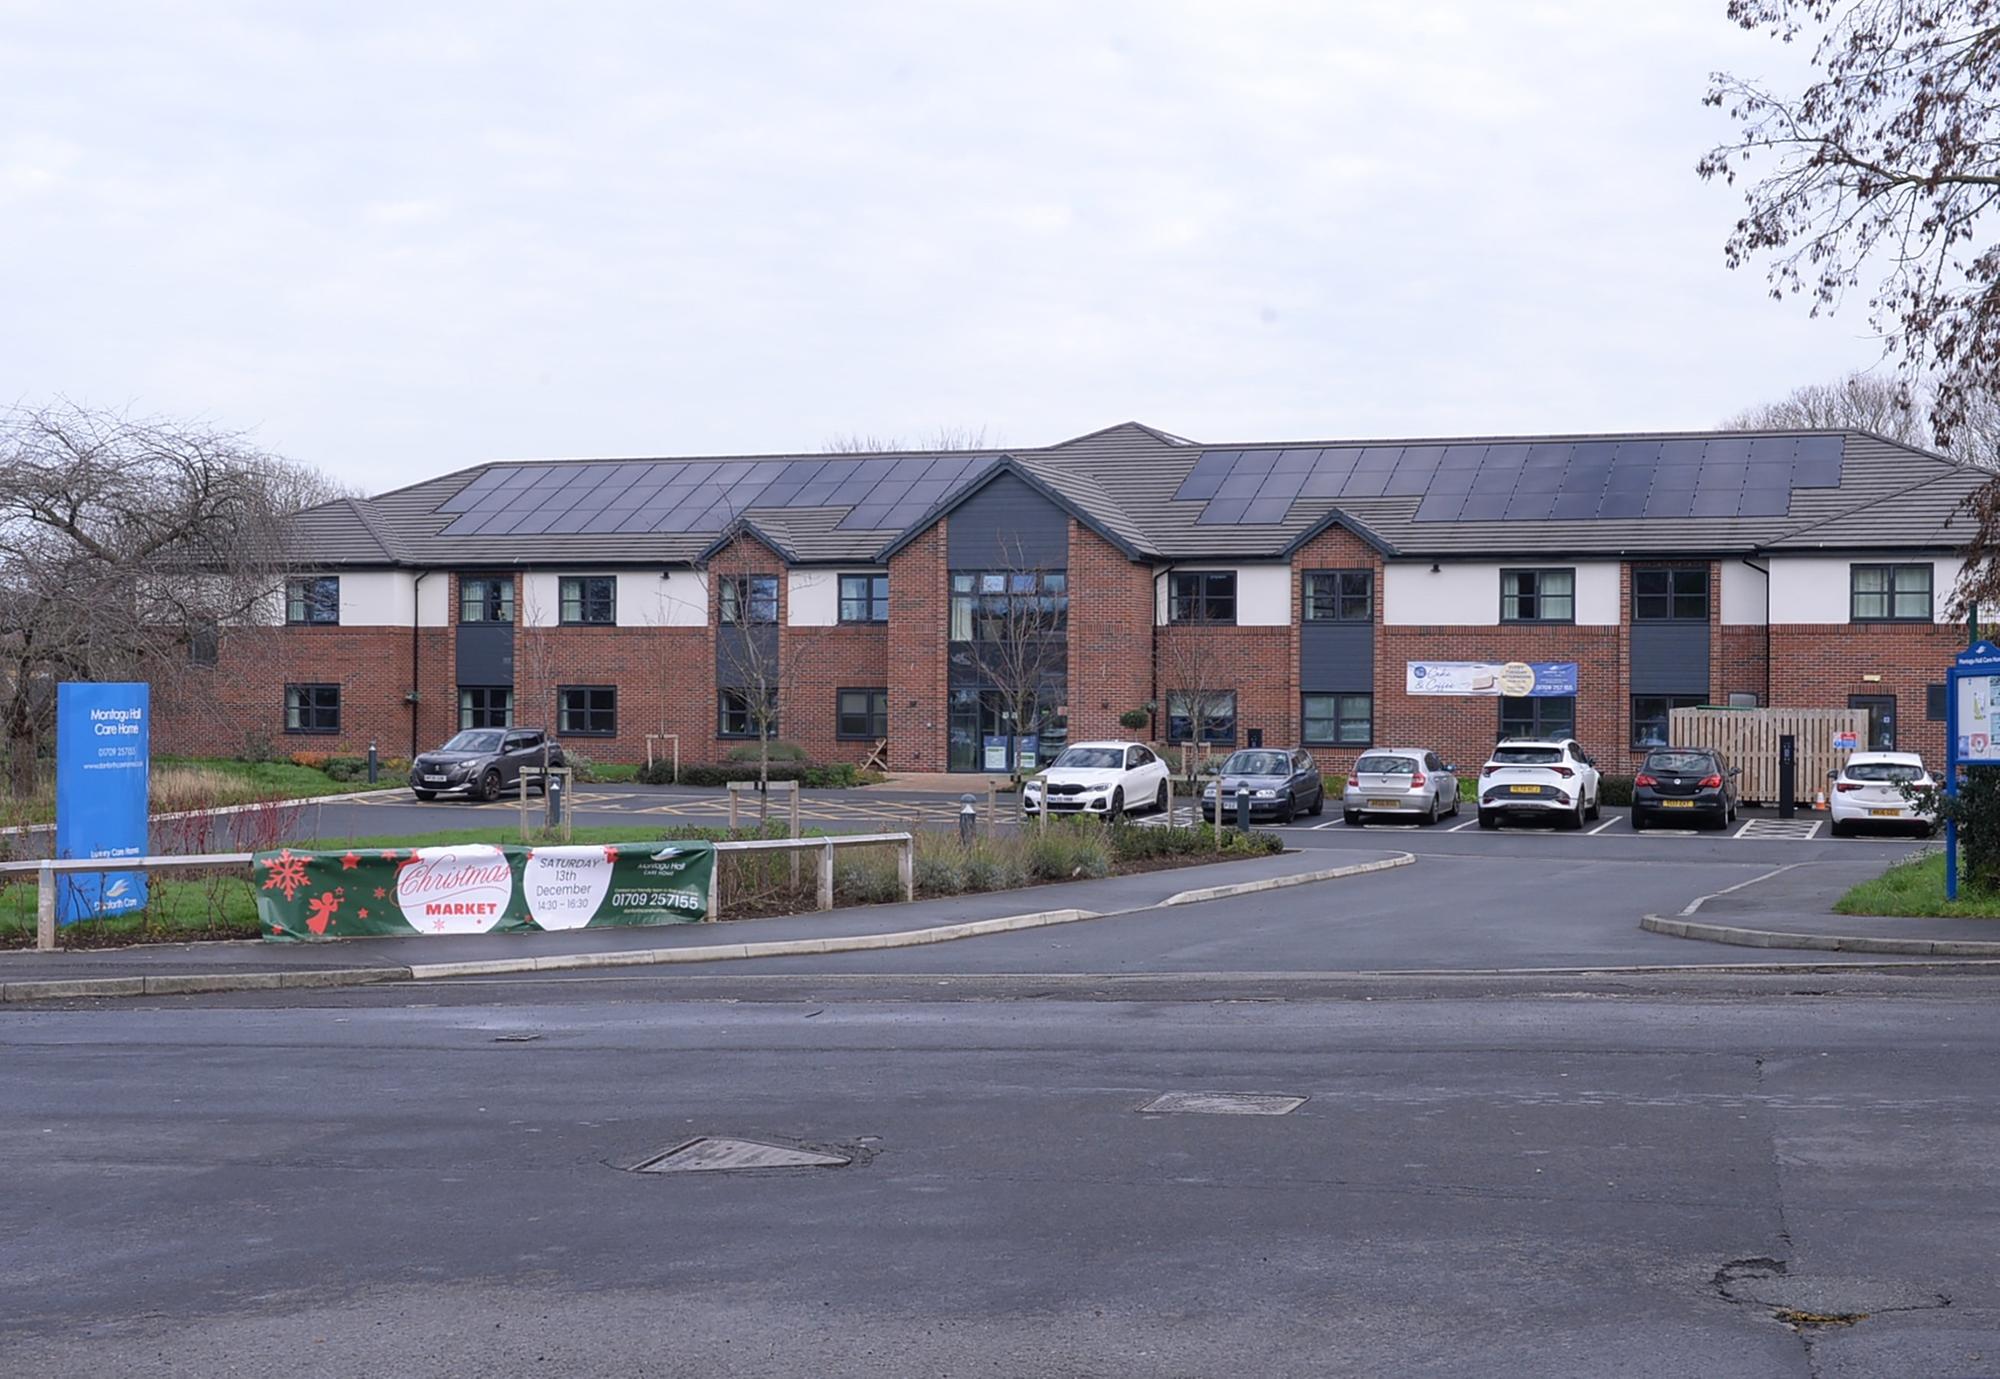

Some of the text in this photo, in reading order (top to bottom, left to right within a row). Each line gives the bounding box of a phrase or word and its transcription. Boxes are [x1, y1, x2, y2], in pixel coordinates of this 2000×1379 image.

[90, 707, 142, 722] Montagu Hall
[94, 722, 139, 735] Care Home
[539, 857, 600, 869] SATURDAY
[637, 861, 686, 871] Montagu Hall
[399, 853, 511, 897] Christmas
[555, 869, 577, 881] 13th
[536, 884, 591, 897] December
[538, 900, 558, 911] 14:30
[567, 898, 589, 909] 16:30
[611, 893, 699, 910] 01709 257155
[426, 903, 497, 916] MARKET
